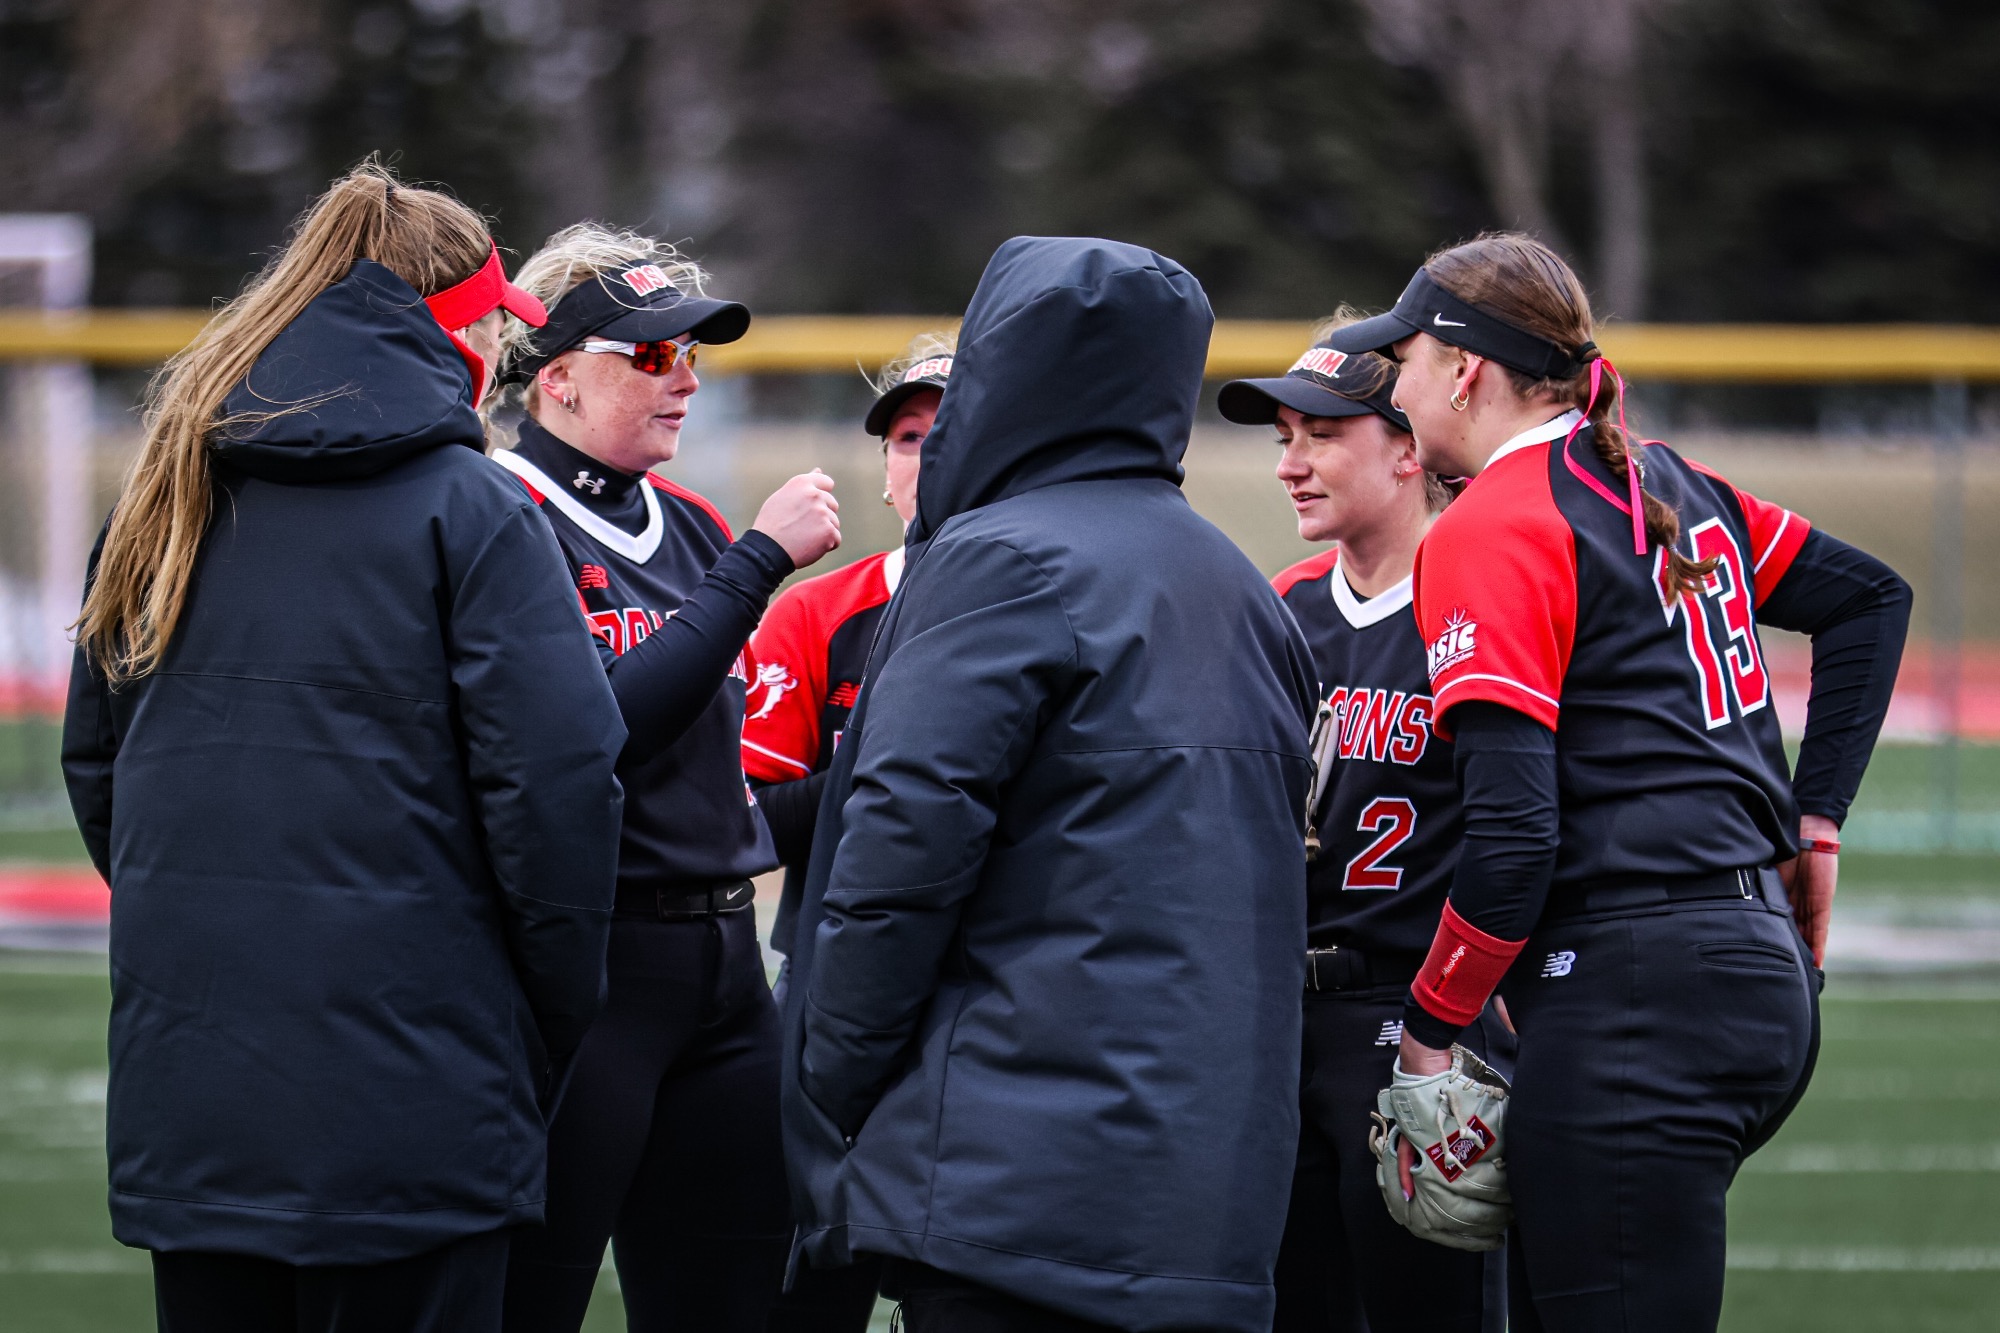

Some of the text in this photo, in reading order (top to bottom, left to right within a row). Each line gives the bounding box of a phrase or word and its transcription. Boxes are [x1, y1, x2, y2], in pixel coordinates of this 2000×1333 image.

[1427, 623, 1477, 675] NSIC
[1652, 516, 1768, 731] 13
[1342, 797, 1418, 891] 2
